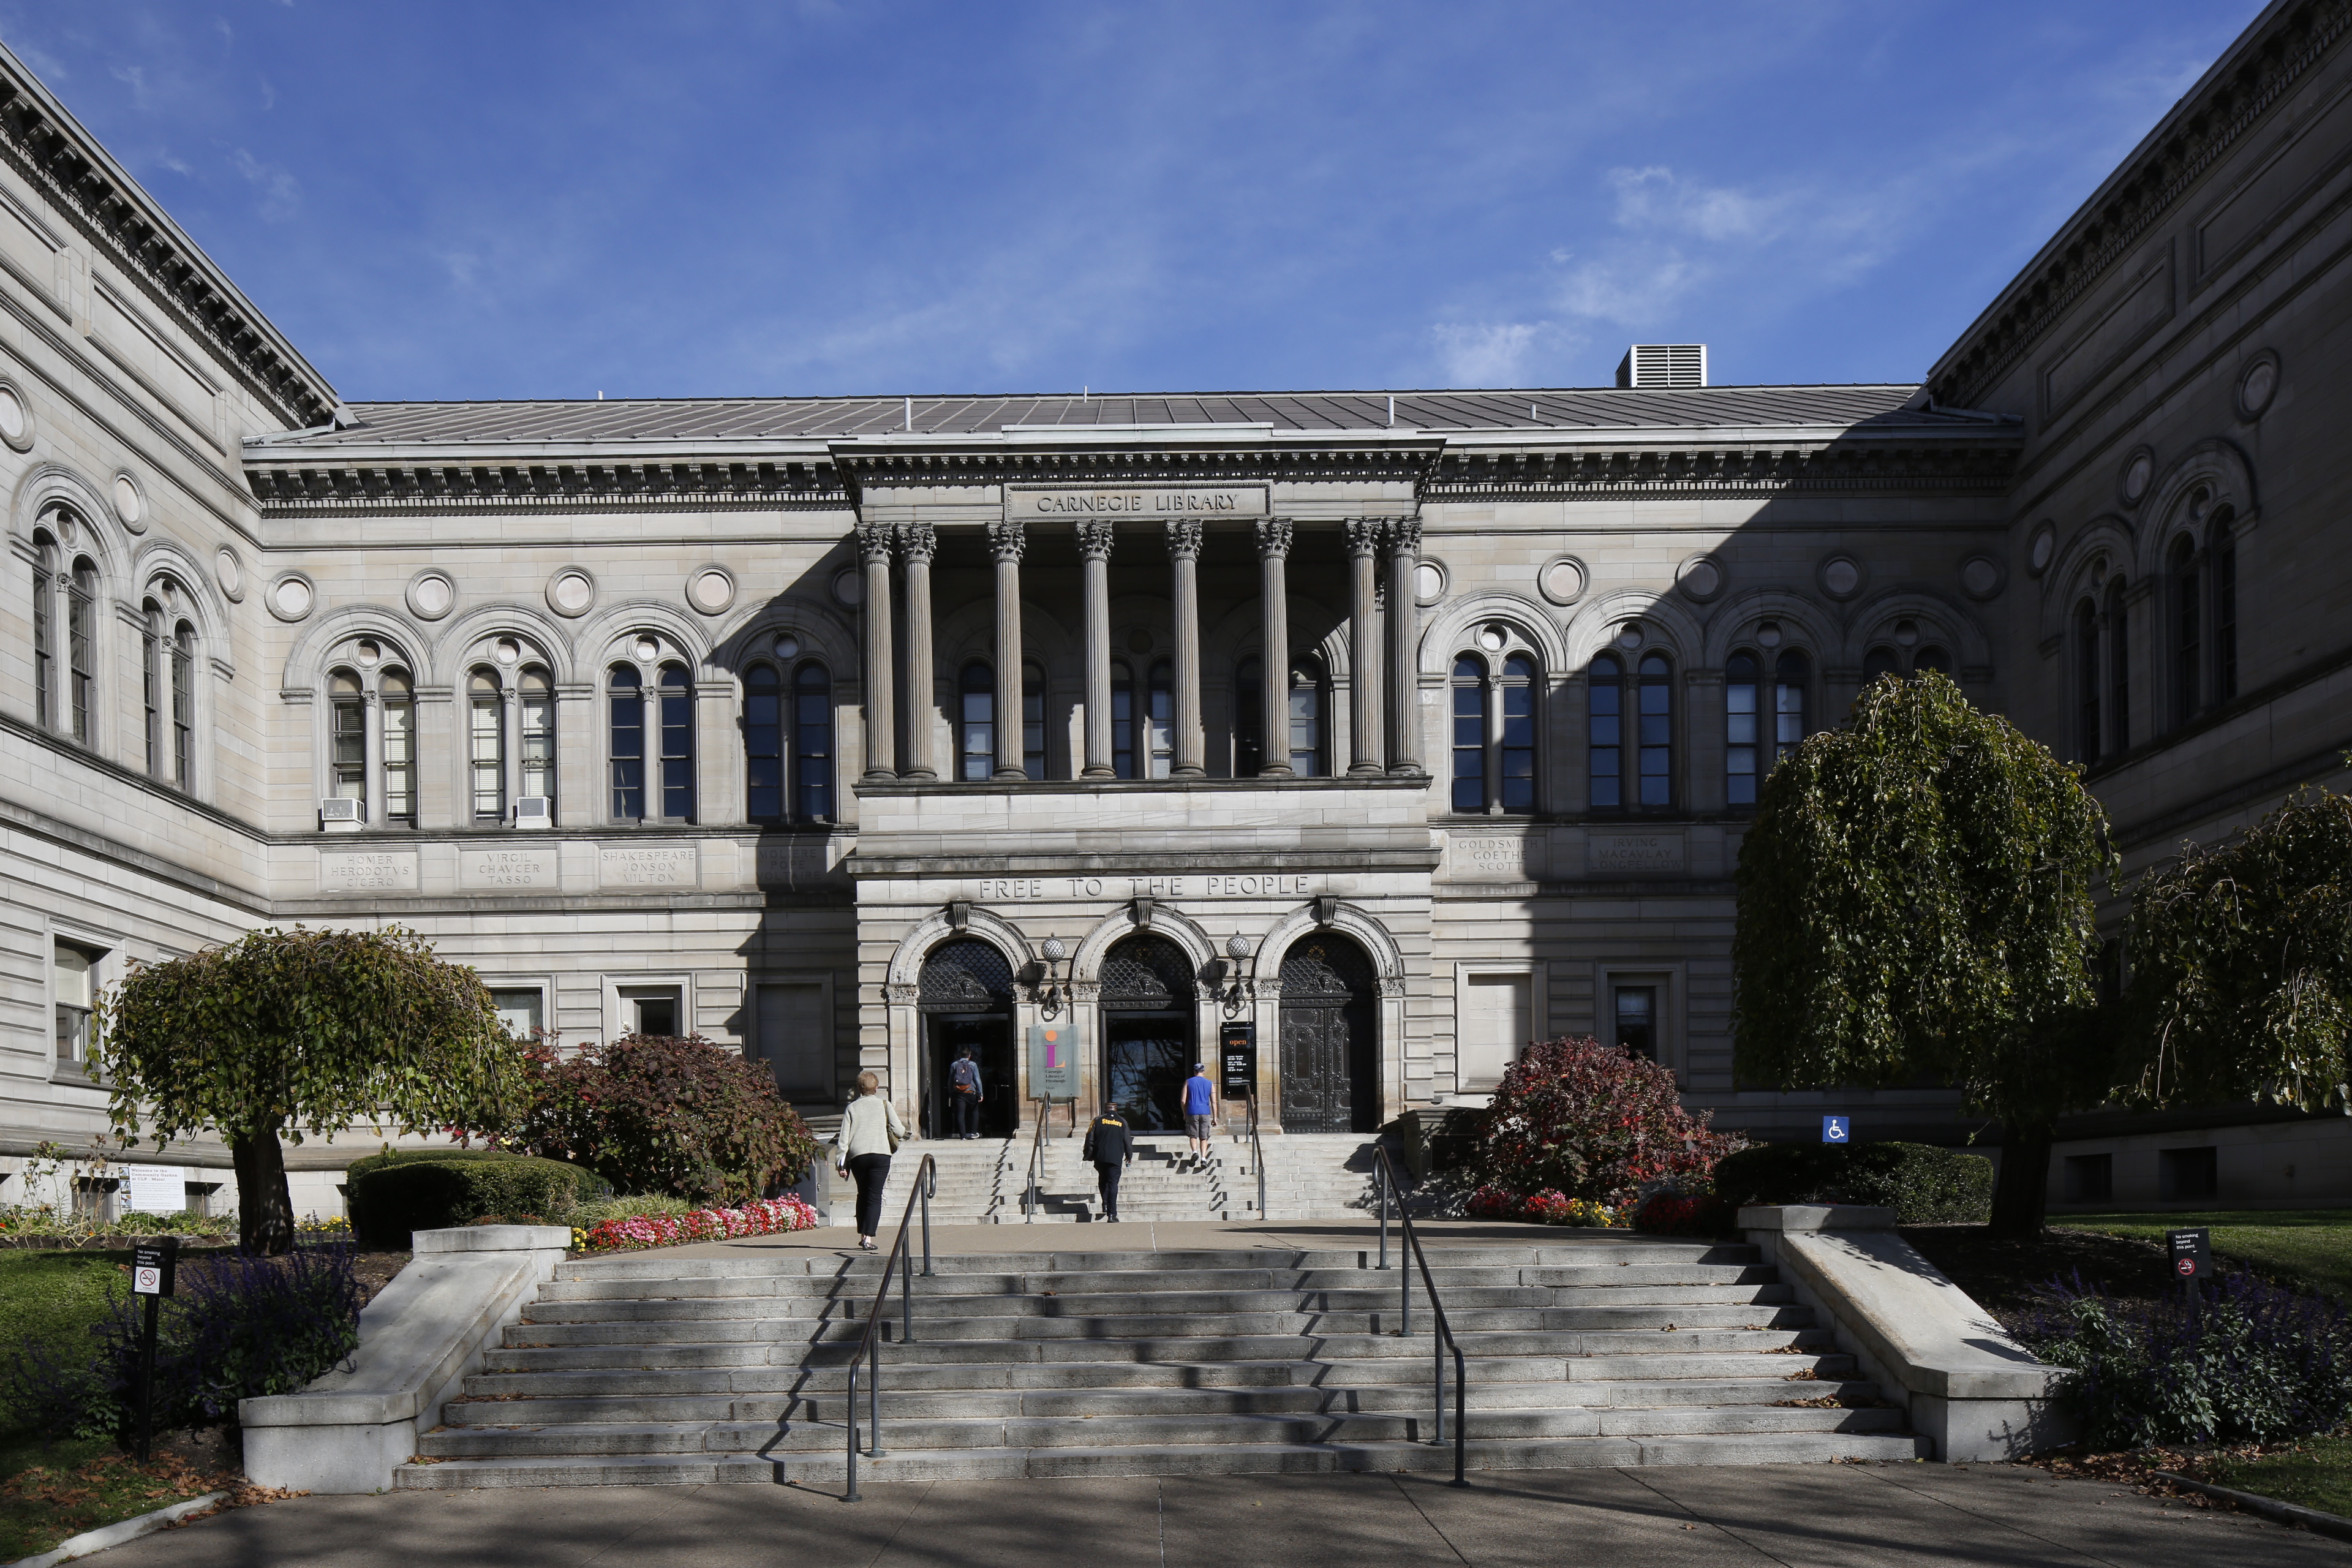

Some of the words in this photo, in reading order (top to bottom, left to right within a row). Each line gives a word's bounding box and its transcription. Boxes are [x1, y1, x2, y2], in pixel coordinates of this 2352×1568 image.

[1037, 495, 1143, 512] CARNEGIE
[1155, 494, 1239, 511] LIBRARY
[1458, 840, 1537, 849] GOLDSMITH
[1613, 838, 1657, 847] IRVING
[487, 853, 531, 862] VIRGIL
[602, 851, 695, 861] SHAKESPEARE
[1473, 851, 1528, 860] GOETHE
[1599, 849, 1672, 858] MACAVLAY
[347, 856, 393, 864] HOMER
[771, 860, 805, 869] POPE
[1591, 860, 1682, 869] LONGFELLOW
[479, 864, 540, 873] CHAVCER
[623, 862, 675, 872] JONSON
[1477, 862, 1523, 870] SCOTT
[331, 866, 409, 876] HERODOTVS
[756, 871, 821, 880] VOLTAIRE
[347, 878, 394, 887] CICERO
[487, 875, 531, 884] TASSO
[623, 873, 675, 883] MILTON
[979, 880, 1042, 898] FREE
[1066, 879, 1102, 897] TO
[1128, 877, 1183, 895] THE
[1207, 876, 1308, 894] PEOPLE
[1102, 1118, 1122, 1127] Steelers
